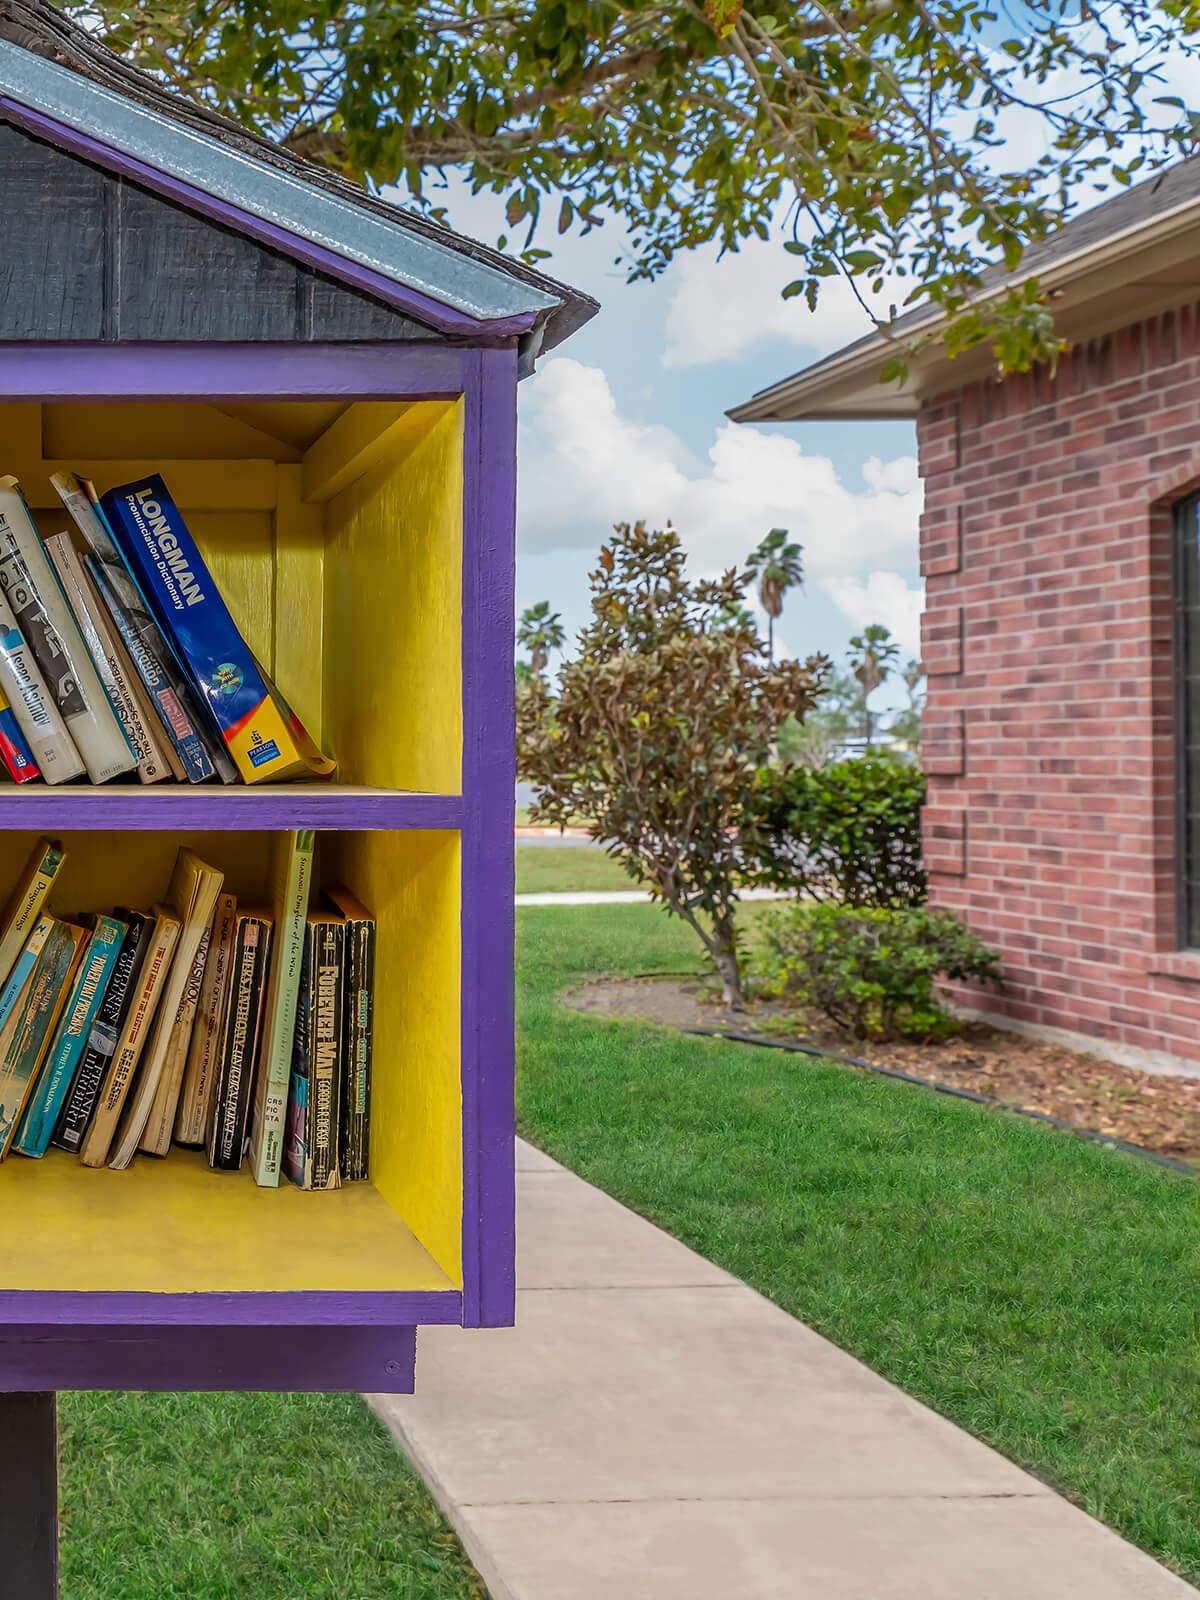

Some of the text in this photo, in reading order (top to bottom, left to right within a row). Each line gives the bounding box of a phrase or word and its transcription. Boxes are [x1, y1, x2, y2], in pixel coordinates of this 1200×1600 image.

[125, 494, 185, 610] Pronunciation Dictionary
[135, 488, 205, 607] LONGMAN
[131, 637, 160, 687] GORDON
[10, 651, 50, 728] Isaac Asimov
[107, 684, 131, 725] ASIMOV
[108, 655, 153, 757] The Solar System and Back
[249, 742, 274, 756] PEARSON
[253, 751, 277, 765] Longman
[16, 882, 47, 931] Dragonwings
[157, 947, 166, 960] THE
[288, 895, 303, 977] Daughter of the Wind
[119, 952, 128, 968] OF
[151, 960, 162, 975] LEFT
[241, 951, 256, 983] PIERS
[67, 955, 107, 1036] POWER THAT PRESERVES
[104, 973, 123, 1014] DUNE
[110, 949, 137, 1022] CHILDREN
[188, 962, 205, 1005] ASIMOV
[316, 966, 339, 1041] FOREVER
[139, 1000, 148, 1012] THE
[234, 985, 252, 1048] ANTHONY
[42, 1043, 72, 1113] STEPHEN DONALDSON
[115, 1048, 135, 1080] ISAAC
[228, 1048, 244, 1099] UNICORN
[316, 1041, 337, 1079] MAN
[67, 1052, 97, 1127] HERBERT
[79, 1064, 103, 1120] FRANK
[266, 1105, 278, 1114] FIC
[267, 1097, 283, 1105] CRS
[317, 1080, 331, 1108] GORDON
[223, 1100, 237, 1137] POINT
[265, 1115, 279, 1123] STA
[315, 1117, 330, 1148] DICKSON
